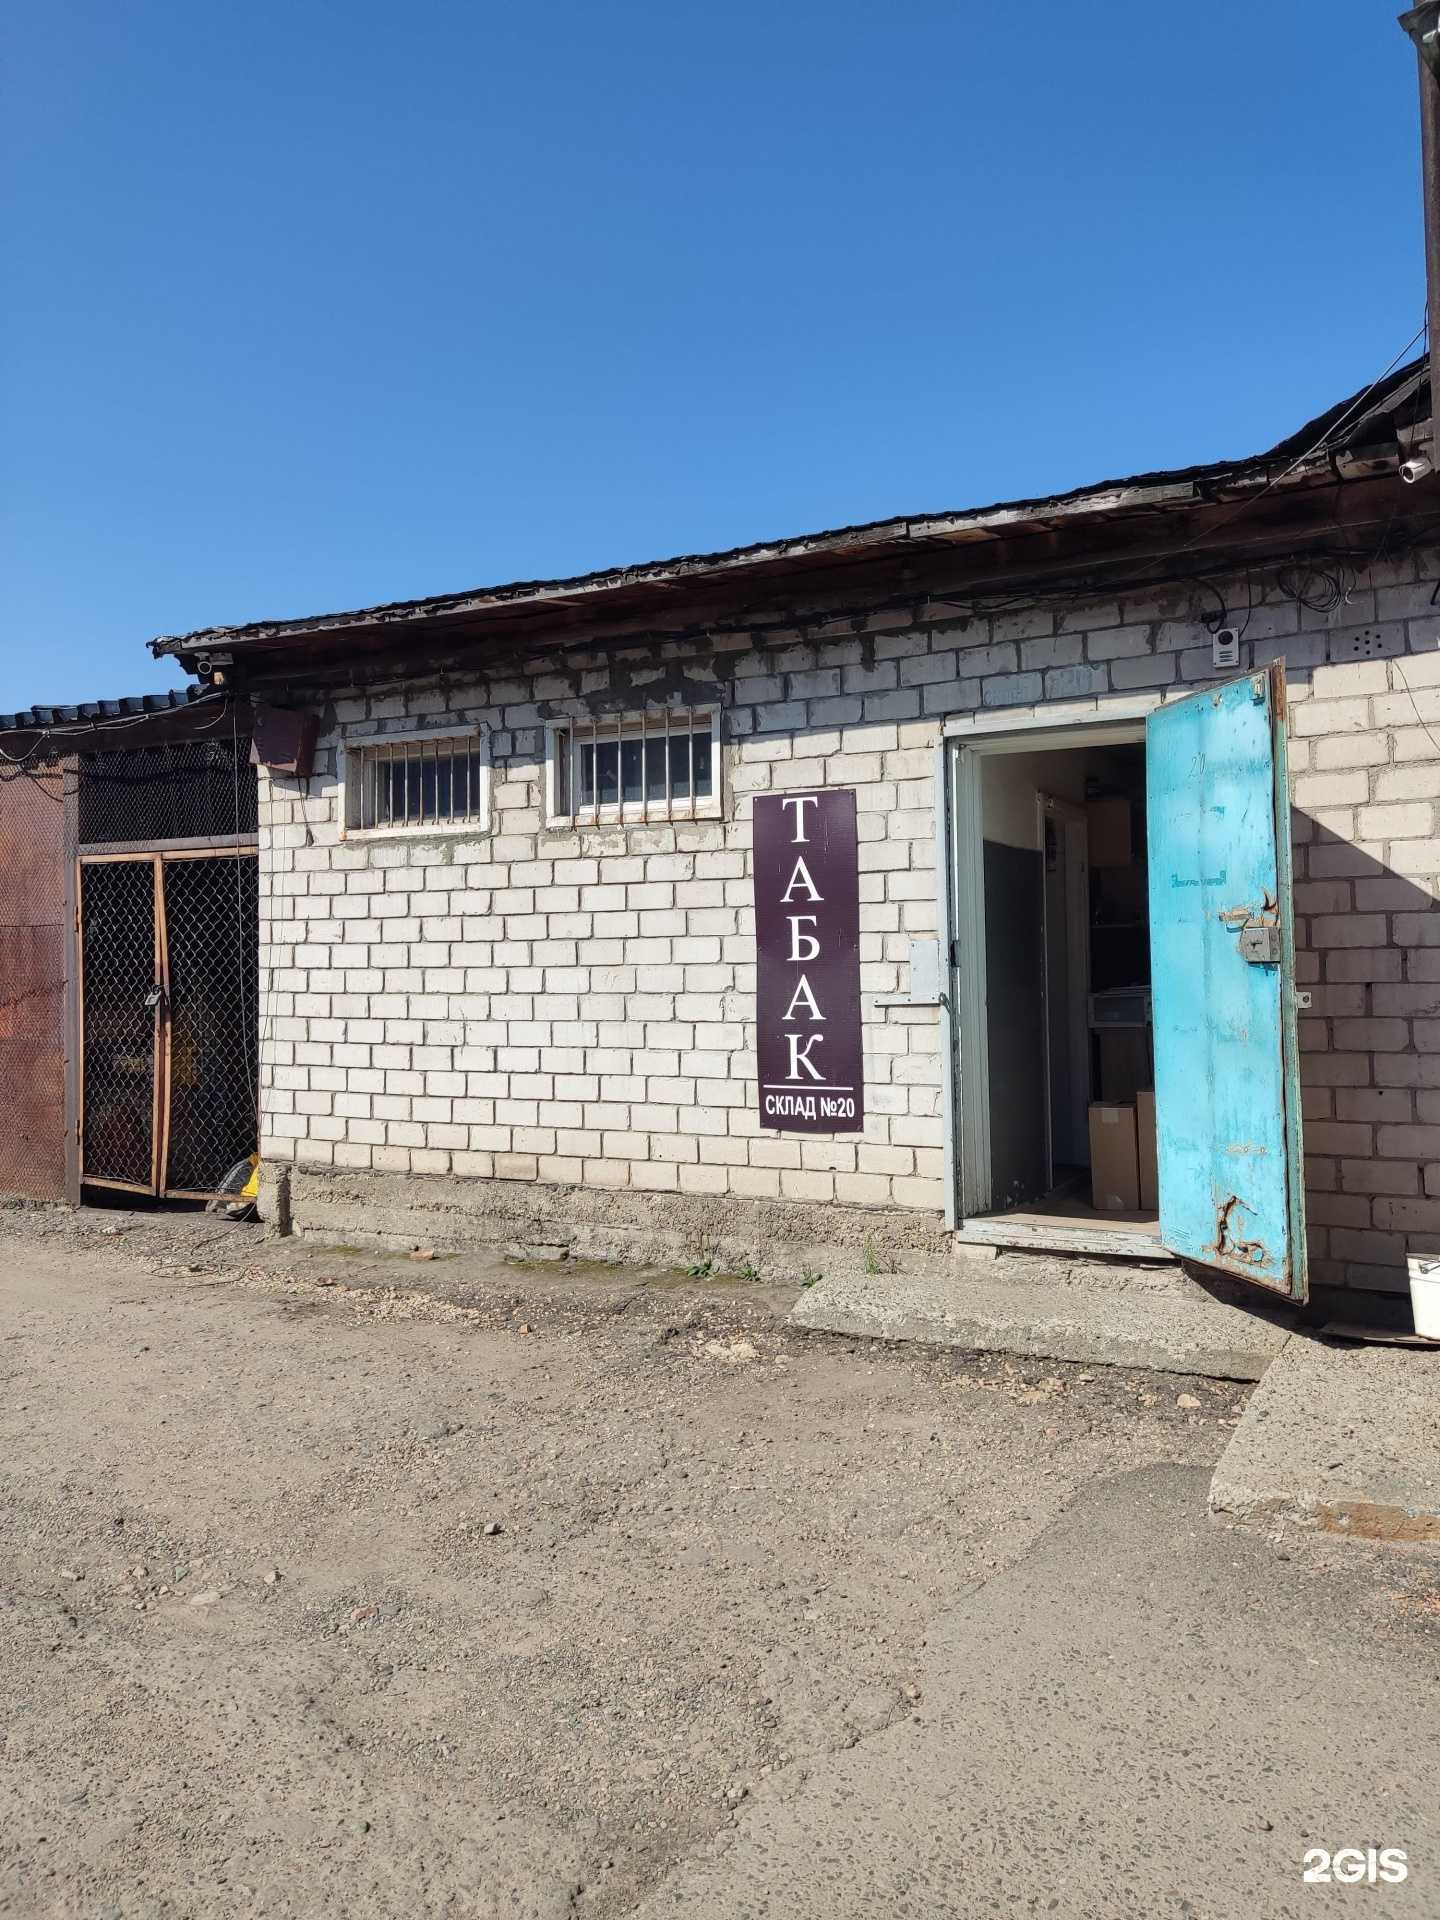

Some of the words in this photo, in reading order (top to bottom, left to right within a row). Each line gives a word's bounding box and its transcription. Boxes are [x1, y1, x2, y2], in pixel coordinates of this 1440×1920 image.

[780, 796, 827, 1080] ТАБАК
[765, 1095, 817, 1120] СКЛАД
[820, 1097, 855, 1118] №20
